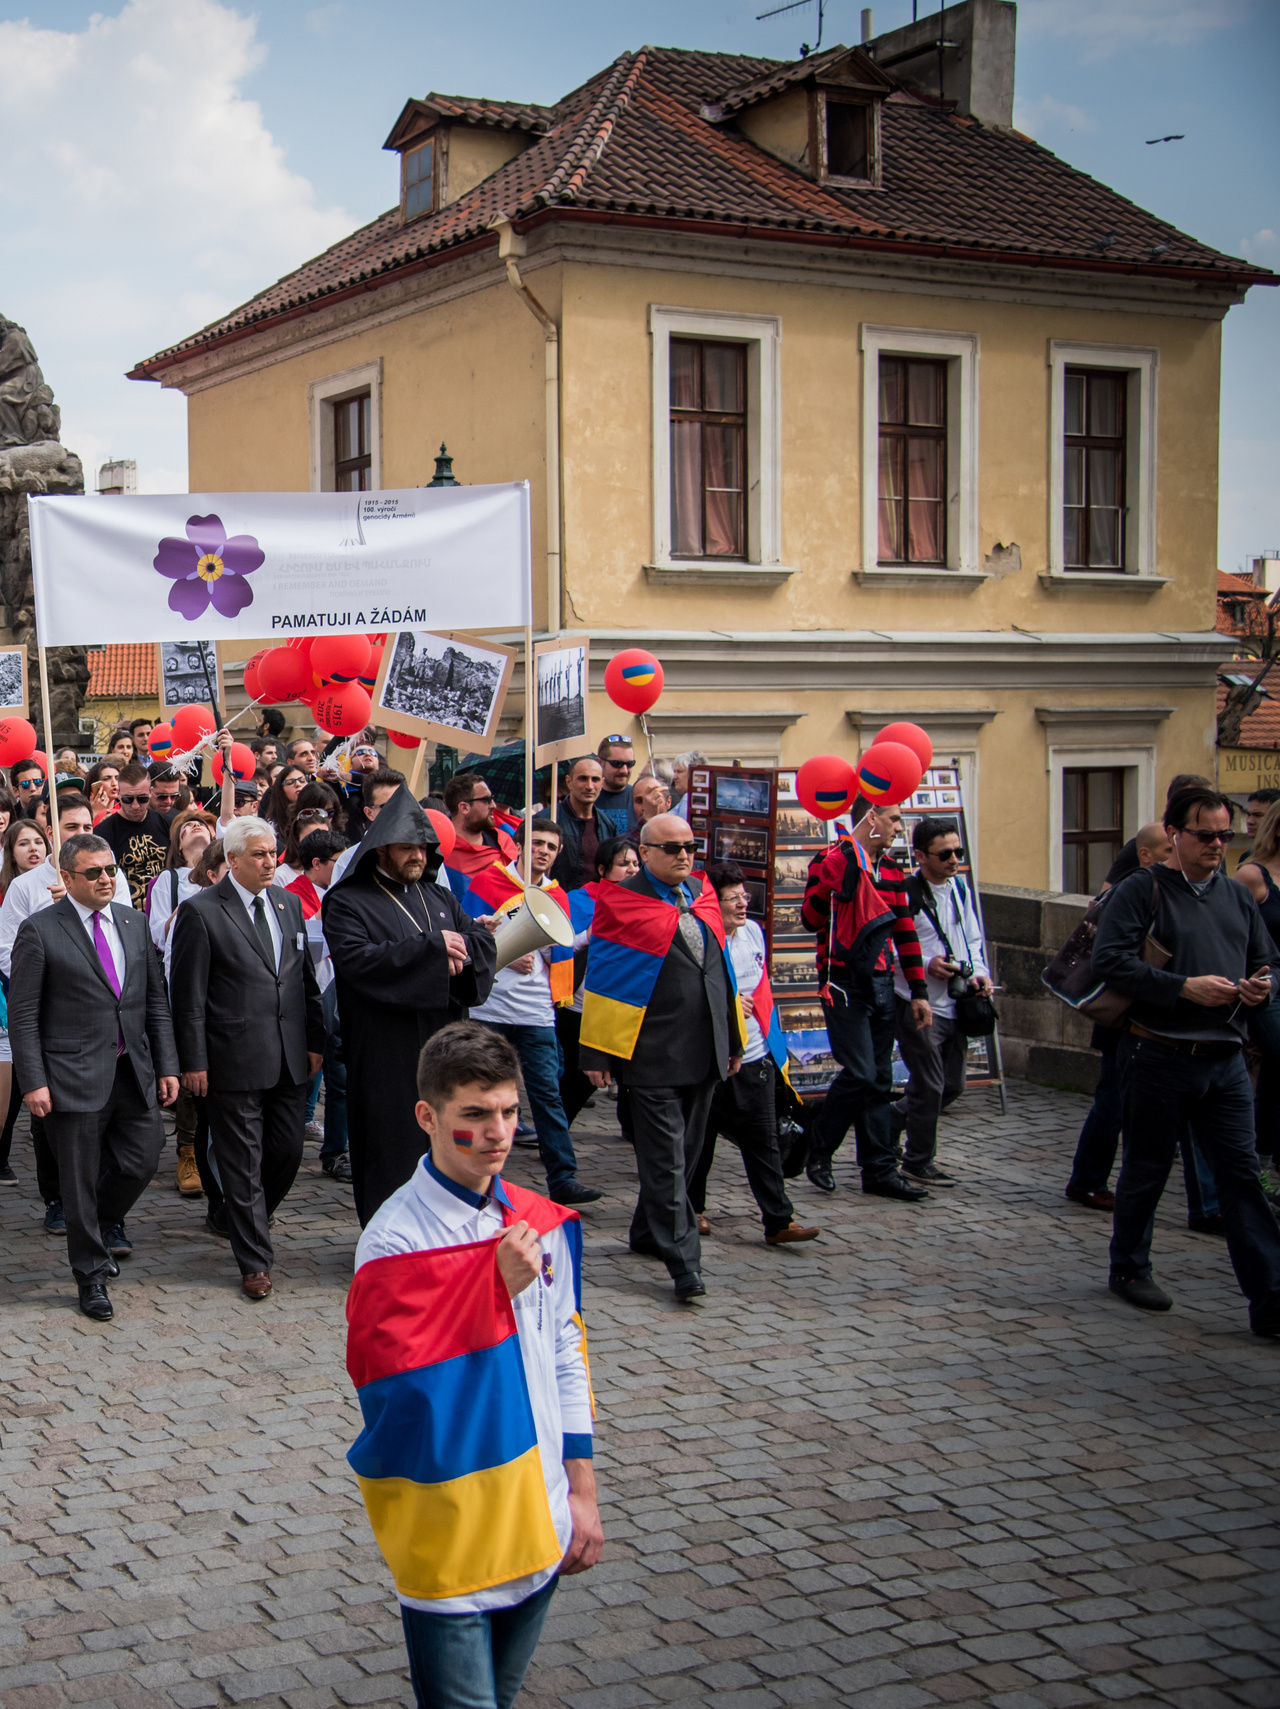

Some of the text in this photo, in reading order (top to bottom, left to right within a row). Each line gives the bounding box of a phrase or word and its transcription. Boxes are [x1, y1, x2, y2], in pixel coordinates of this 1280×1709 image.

[278, 581, 326, 591] REMEMBER
[328, 580, 347, 589] AND
[349, 578, 388, 588] DEMAND
[272, 606, 426, 629] PAMATUJI A ŽÁDÁM
[333, 704, 343, 726] 1915
[128, 833, 160, 851] OUR
